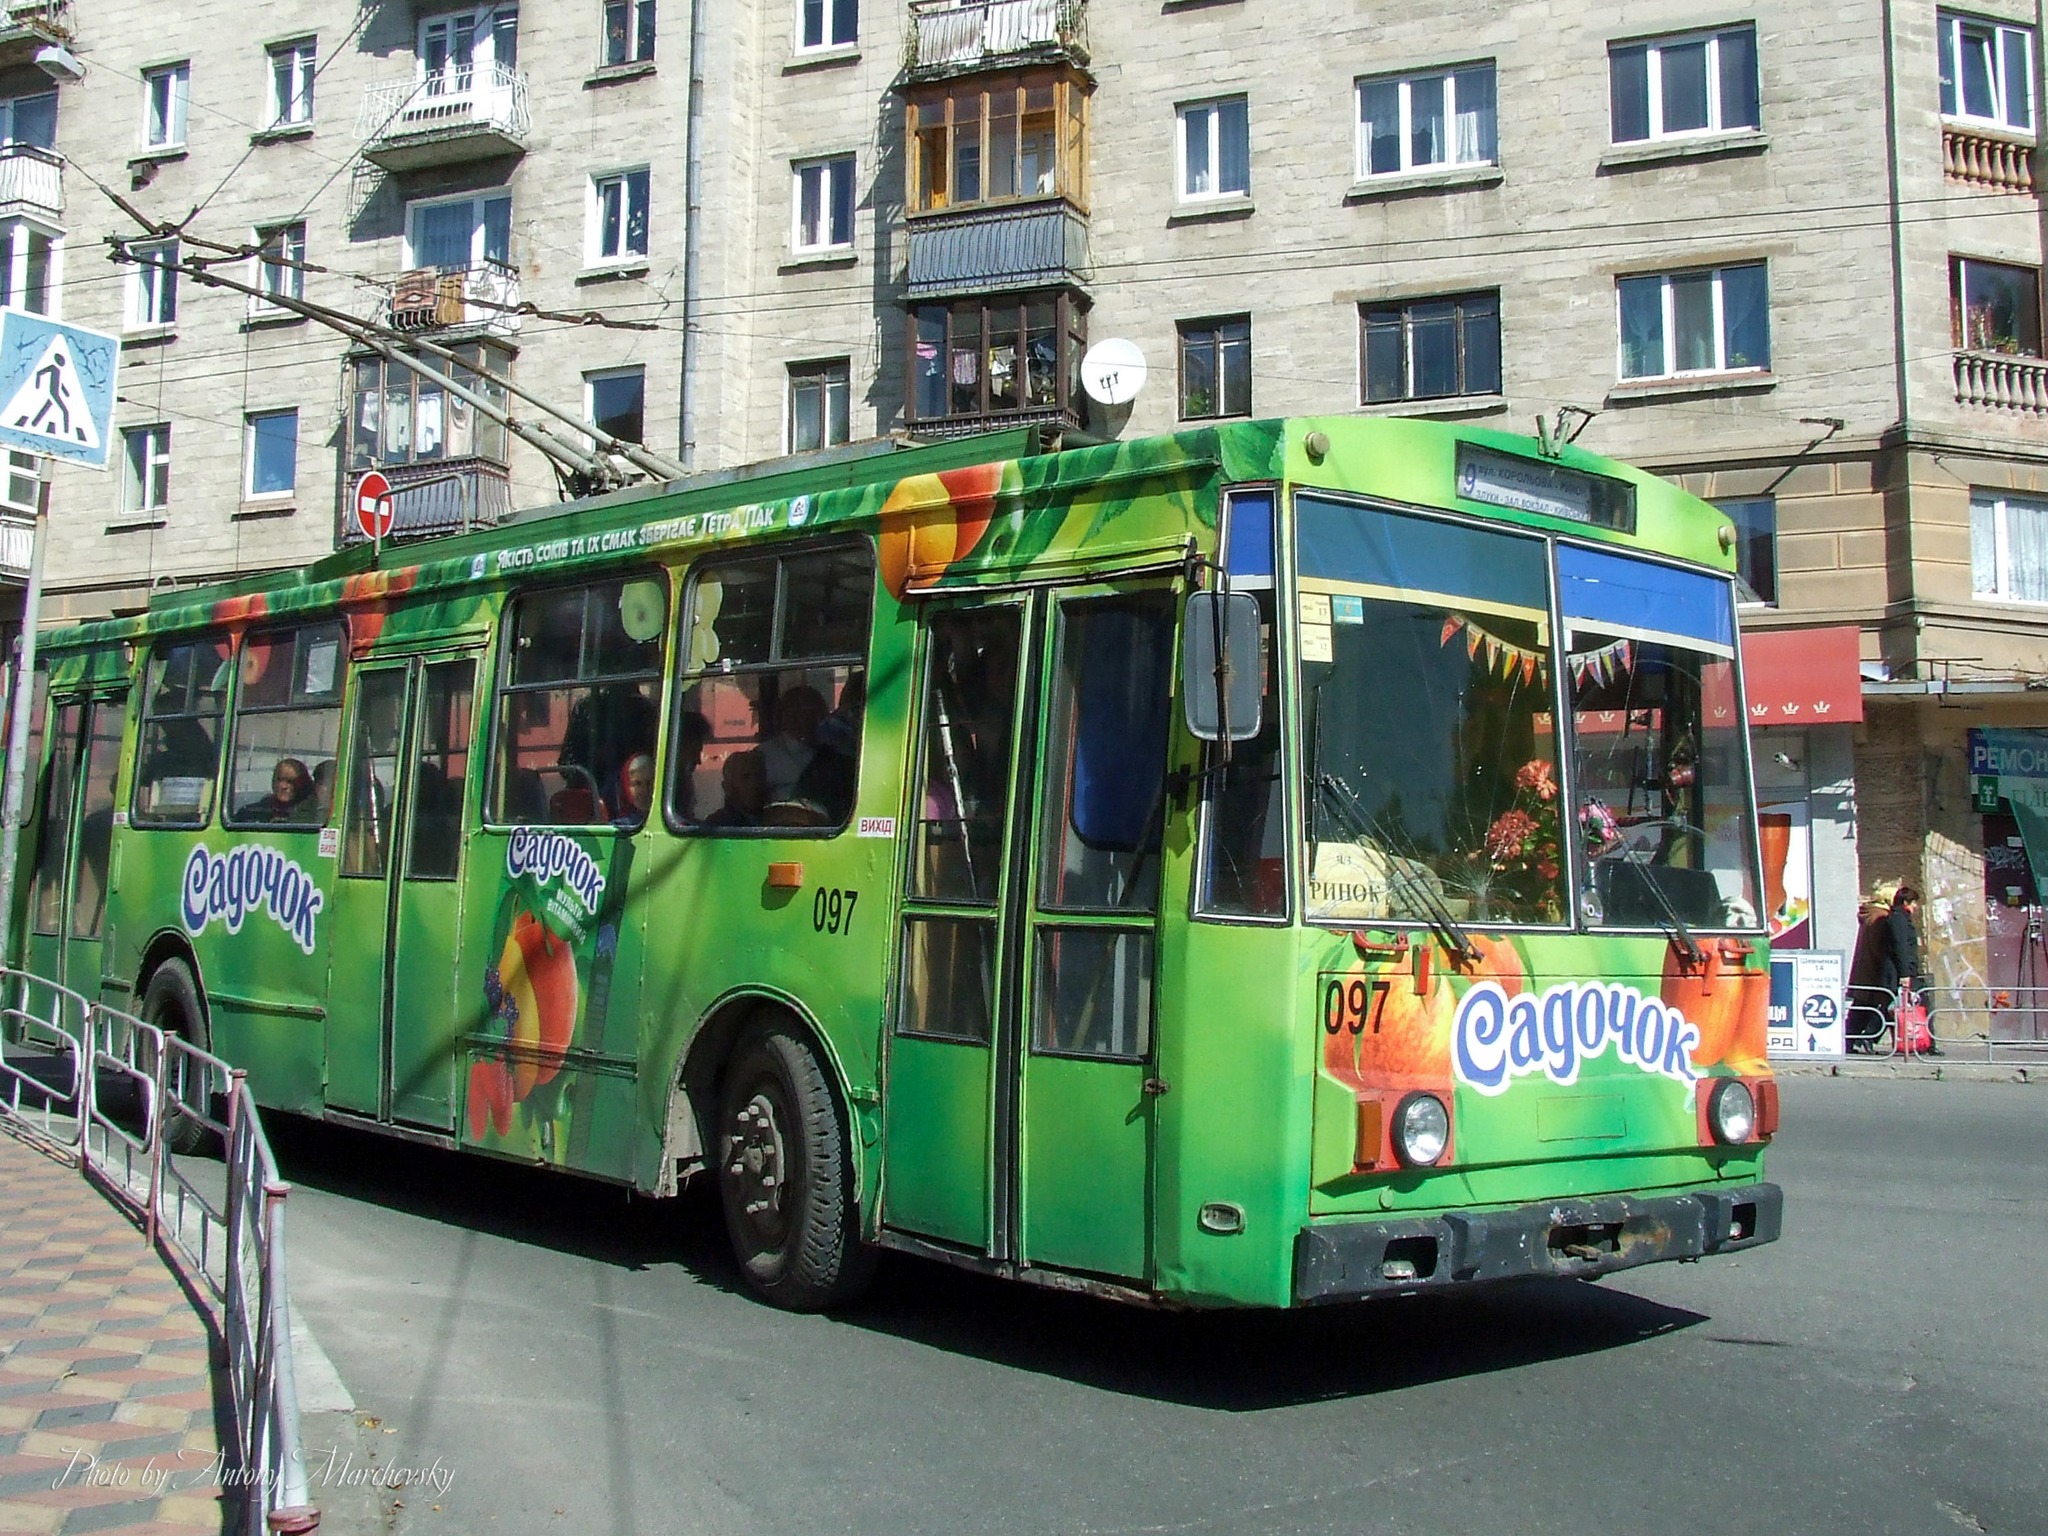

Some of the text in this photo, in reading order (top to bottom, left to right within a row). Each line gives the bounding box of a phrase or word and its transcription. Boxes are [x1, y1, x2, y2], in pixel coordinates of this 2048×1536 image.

[1464, 462, 1476, 493] 9
[497, 547, 534, 571] ЯКІСТЬ
[536, 541, 569, 563] СОКІВ
[571, 538, 585, 557] ТА
[602, 529, 636, 552] СМАК
[861, 819, 892, 835] ВИХІД
[508, 826, 604, 913] Садочок
[182, 847, 322, 951] Садочок
[813, 886, 859, 936] 097
[1324, 979, 1391, 1035] 097
[1805, 999, 1834, 1017] 24
[1453, 985, 1698, 1091] Садочок
